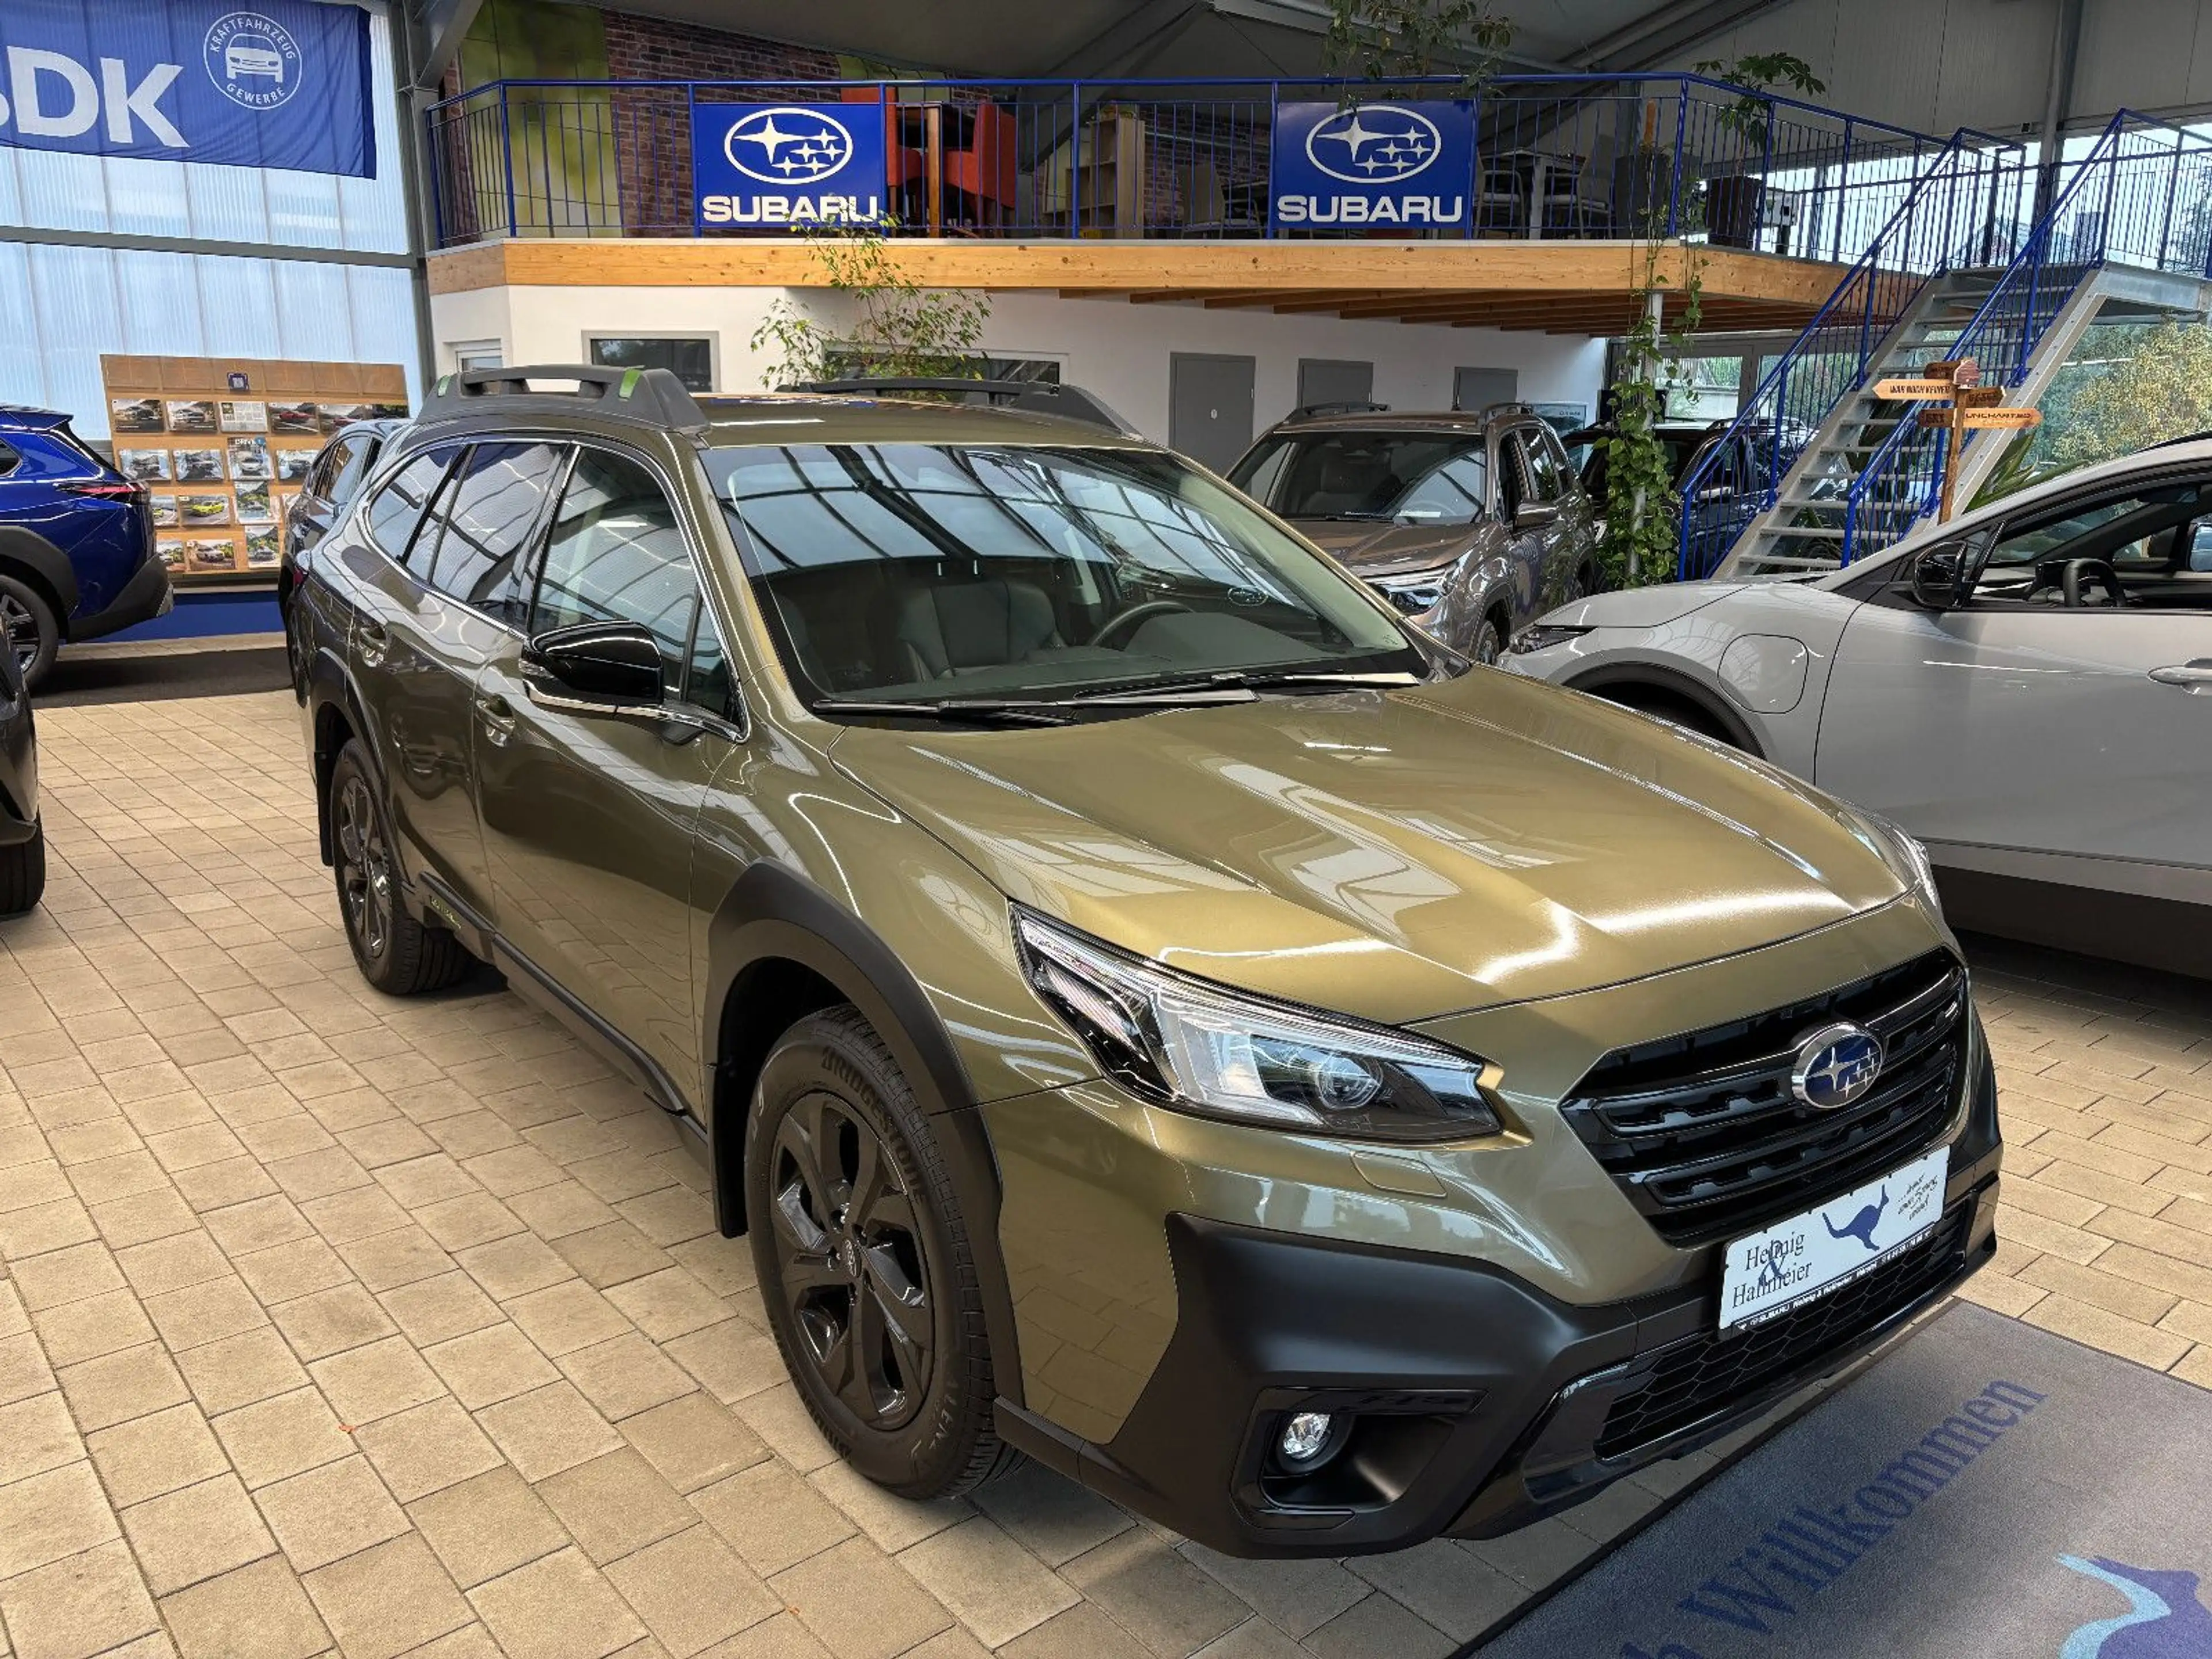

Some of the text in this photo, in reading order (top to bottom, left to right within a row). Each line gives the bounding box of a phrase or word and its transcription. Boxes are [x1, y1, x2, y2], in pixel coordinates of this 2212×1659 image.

[210, 18, 296, 59] KRAFTFAHRZEUG
[0, 46, 190, 147] DK
[226, 83, 285, 104] GEWERBE
[702, 196, 878, 222] SUBARU
[1277, 195, 1463, 222] SUBARU
[1675, 1378, 2048, 1635] Willkommen
